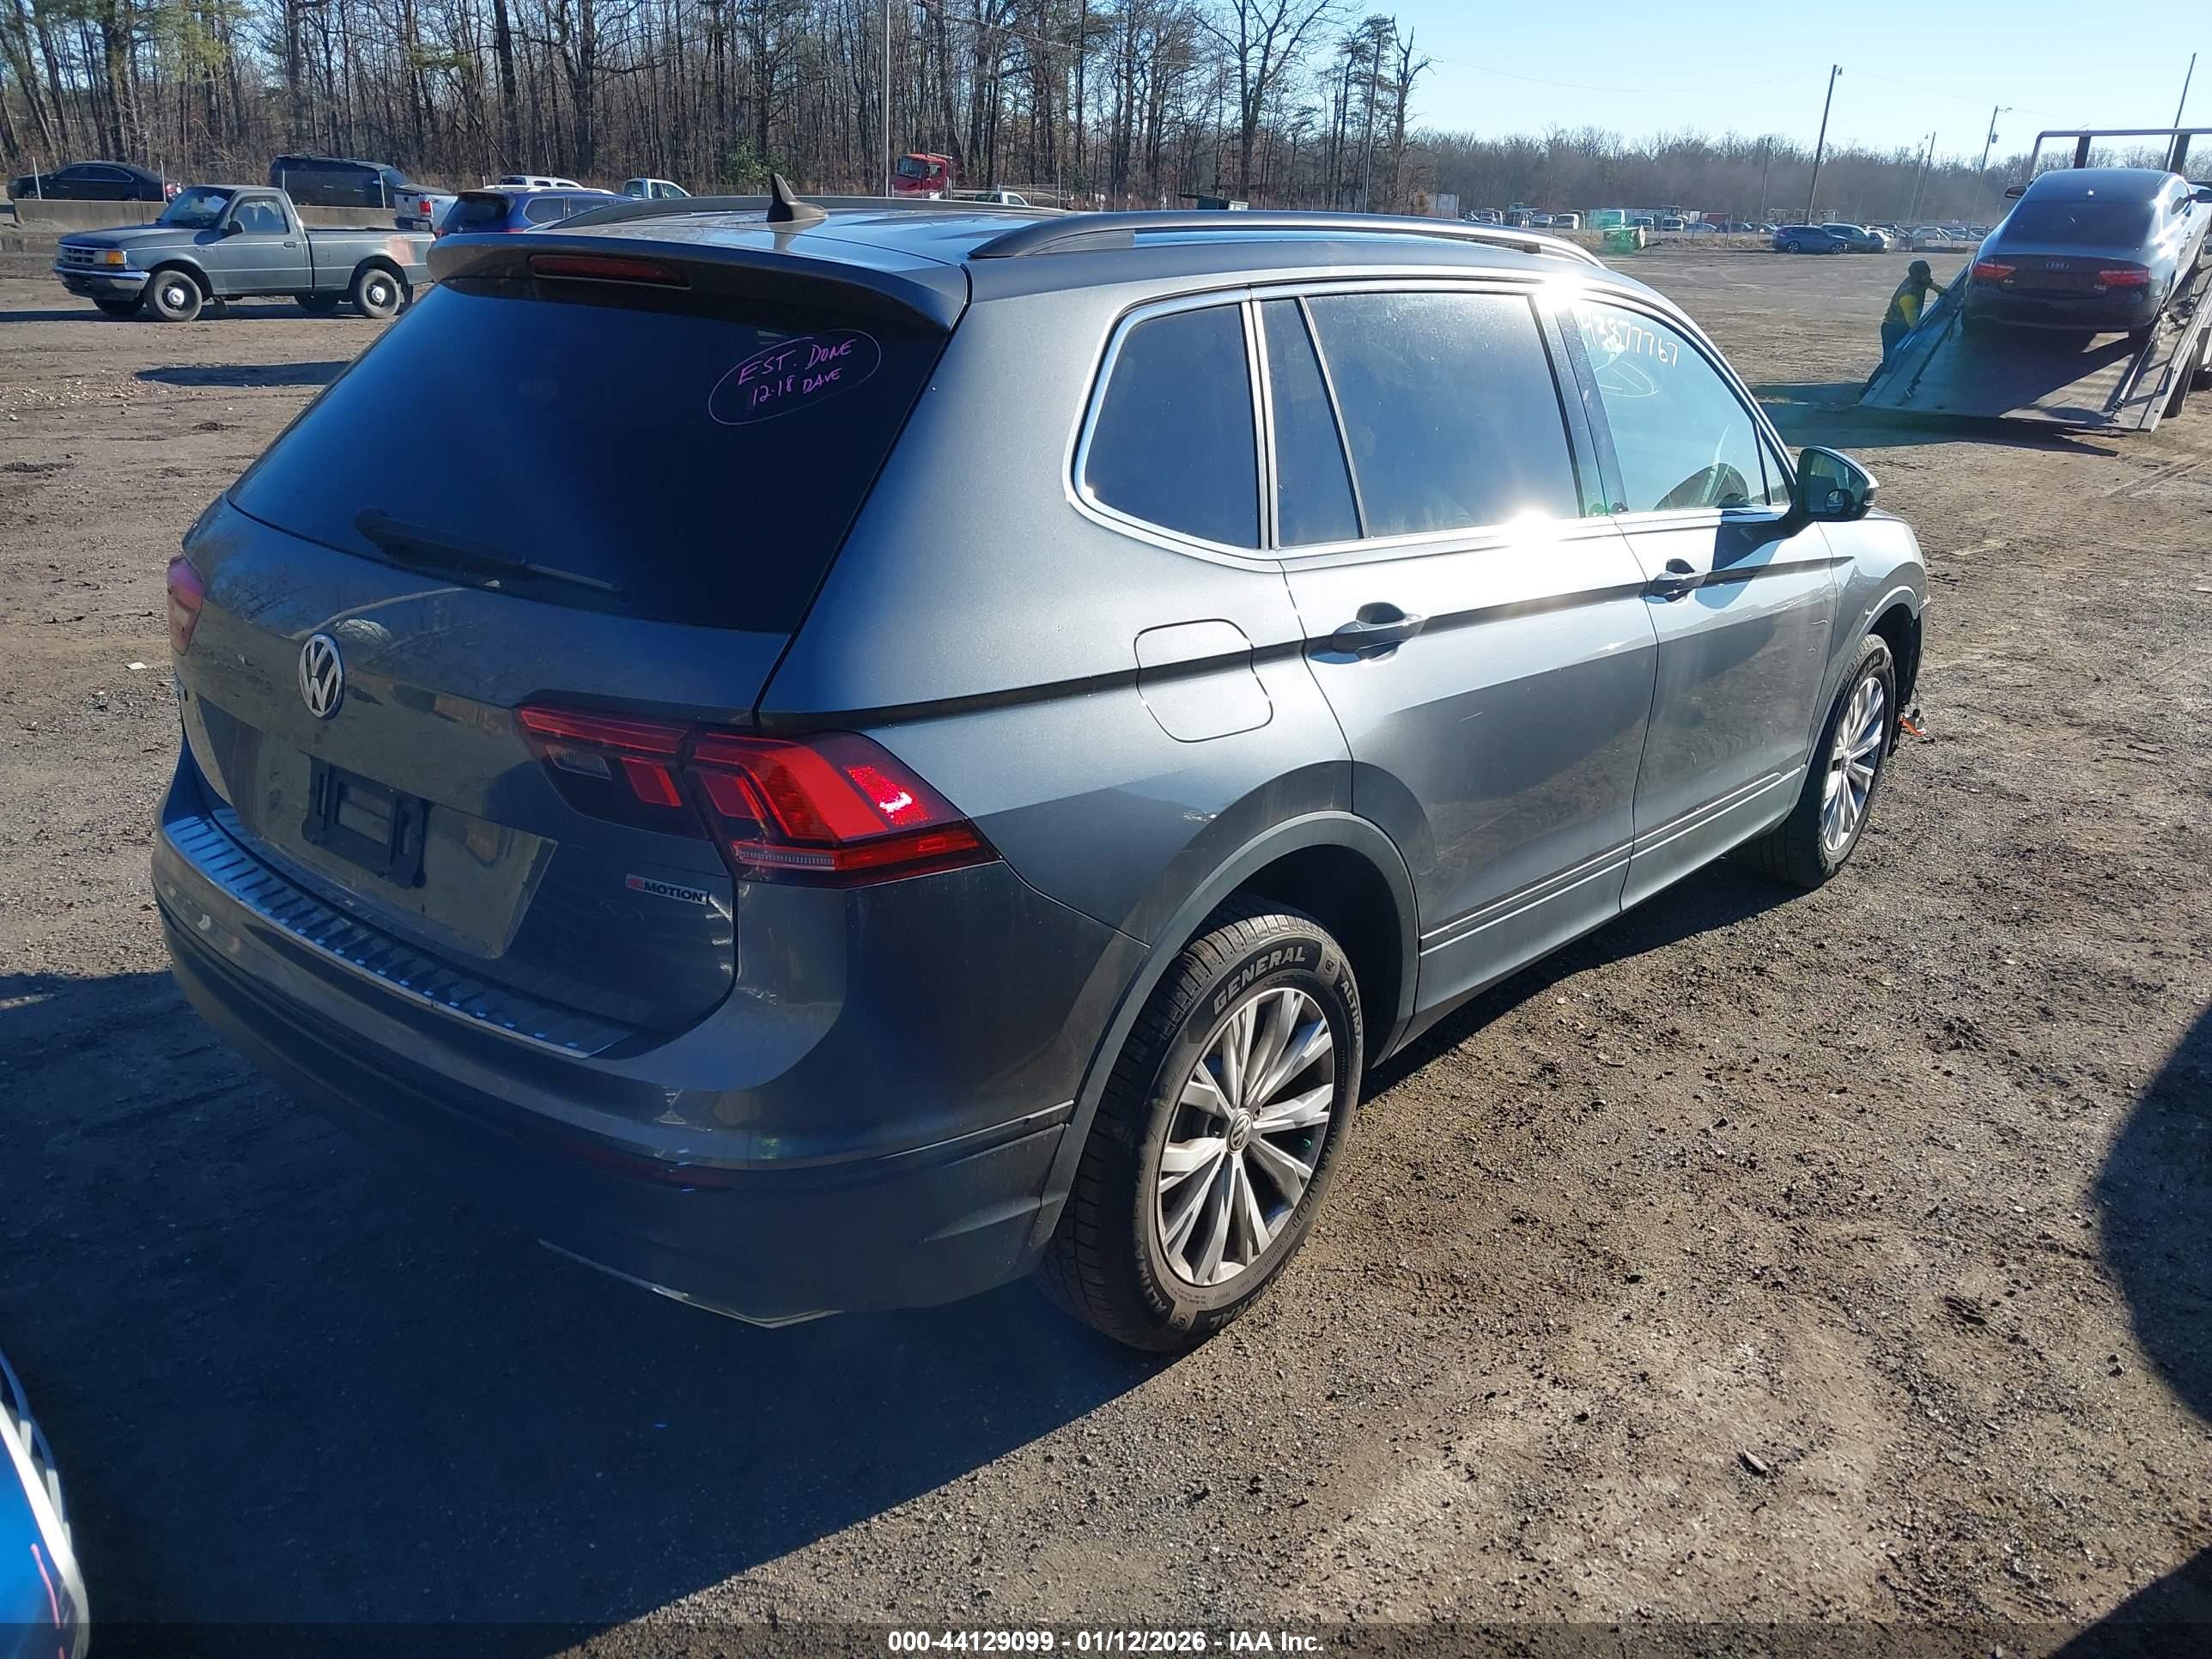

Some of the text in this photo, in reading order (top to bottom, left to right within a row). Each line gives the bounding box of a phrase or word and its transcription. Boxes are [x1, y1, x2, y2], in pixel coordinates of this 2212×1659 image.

[738, 338, 858, 386] EST. DONE
[803, 368, 843, 394] DAVE
[1213, 945, 1306, 1015] GENERAL
